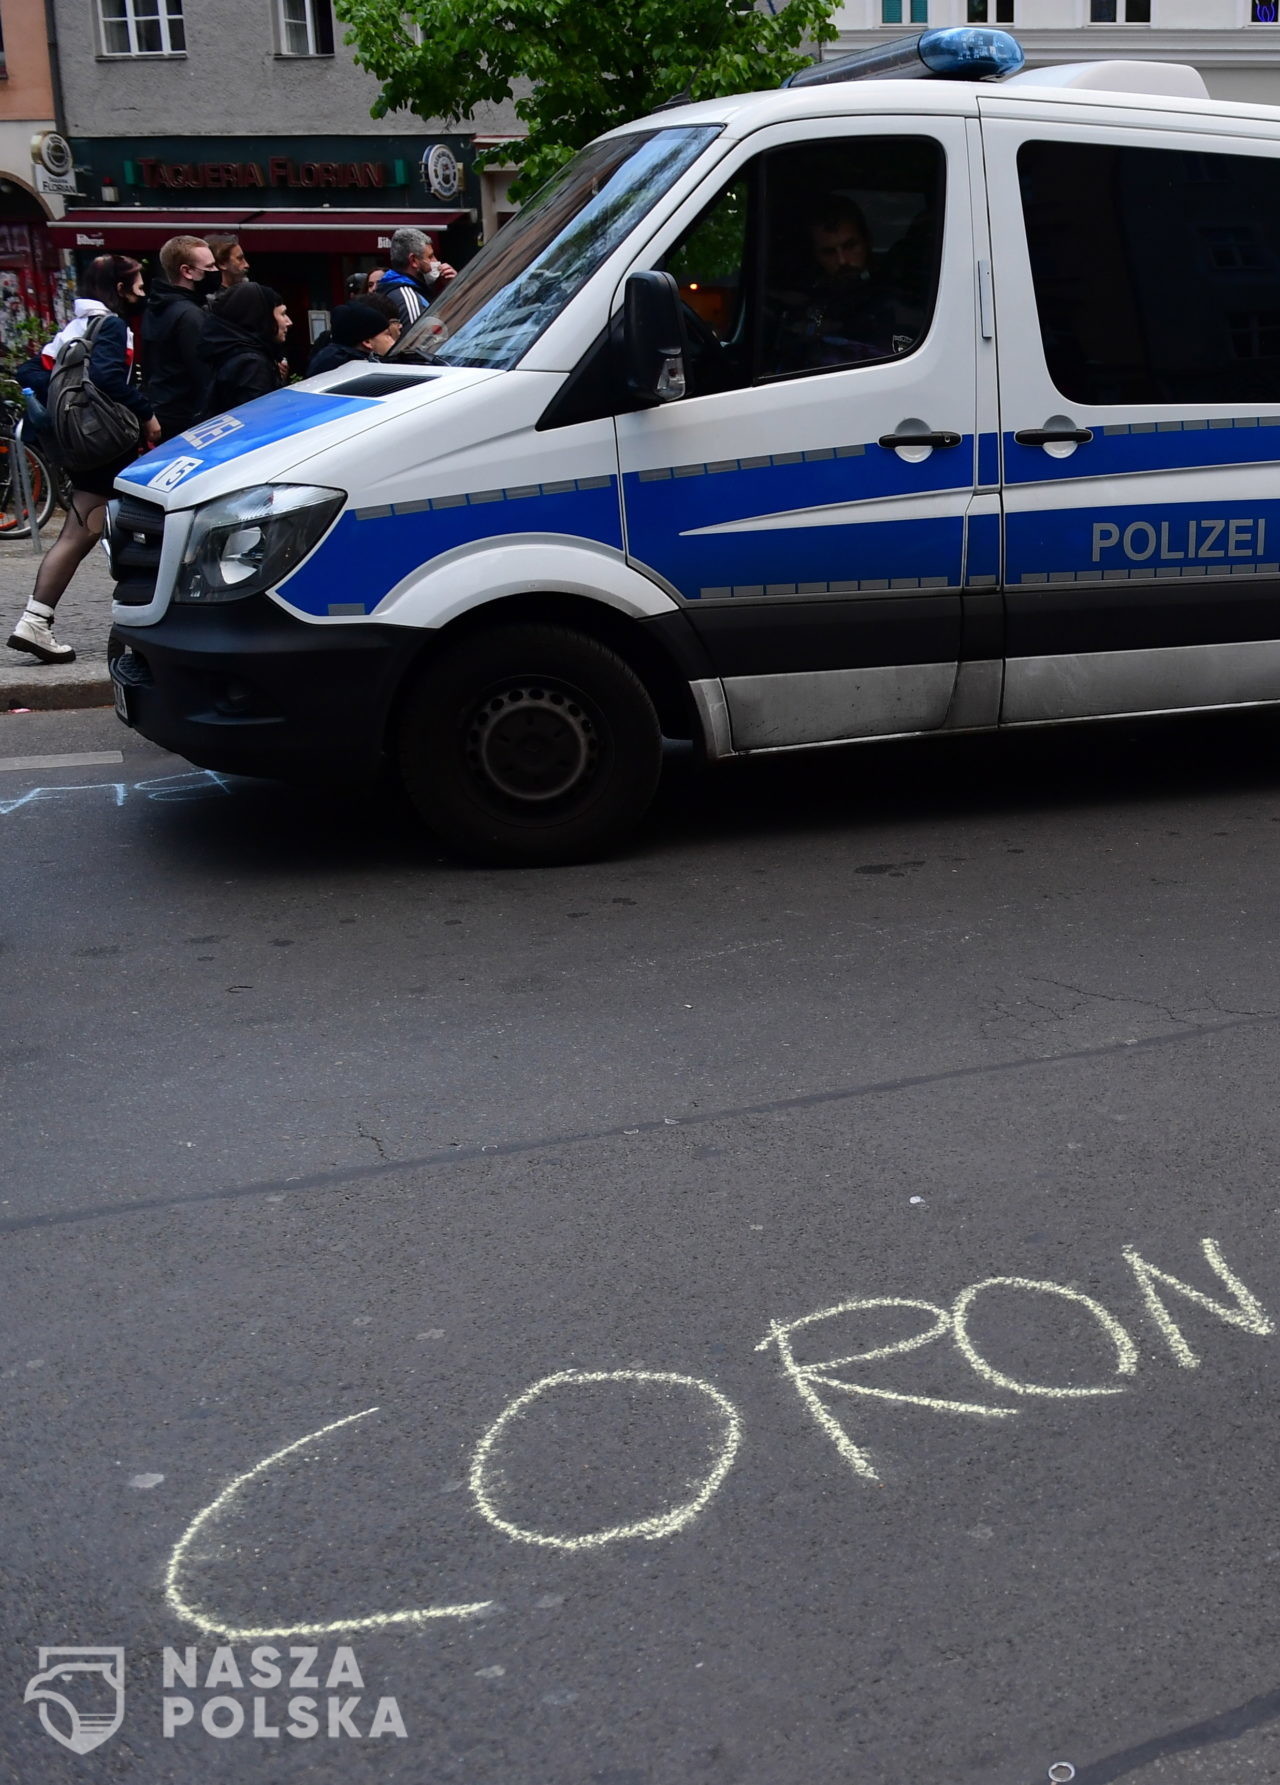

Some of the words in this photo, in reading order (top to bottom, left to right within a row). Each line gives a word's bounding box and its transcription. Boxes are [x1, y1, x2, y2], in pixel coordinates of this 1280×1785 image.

[269, 155, 384, 188] FLORIAN
[155, 460, 195, 486] 15
[1092, 518, 1266, 562] POLIZEI
